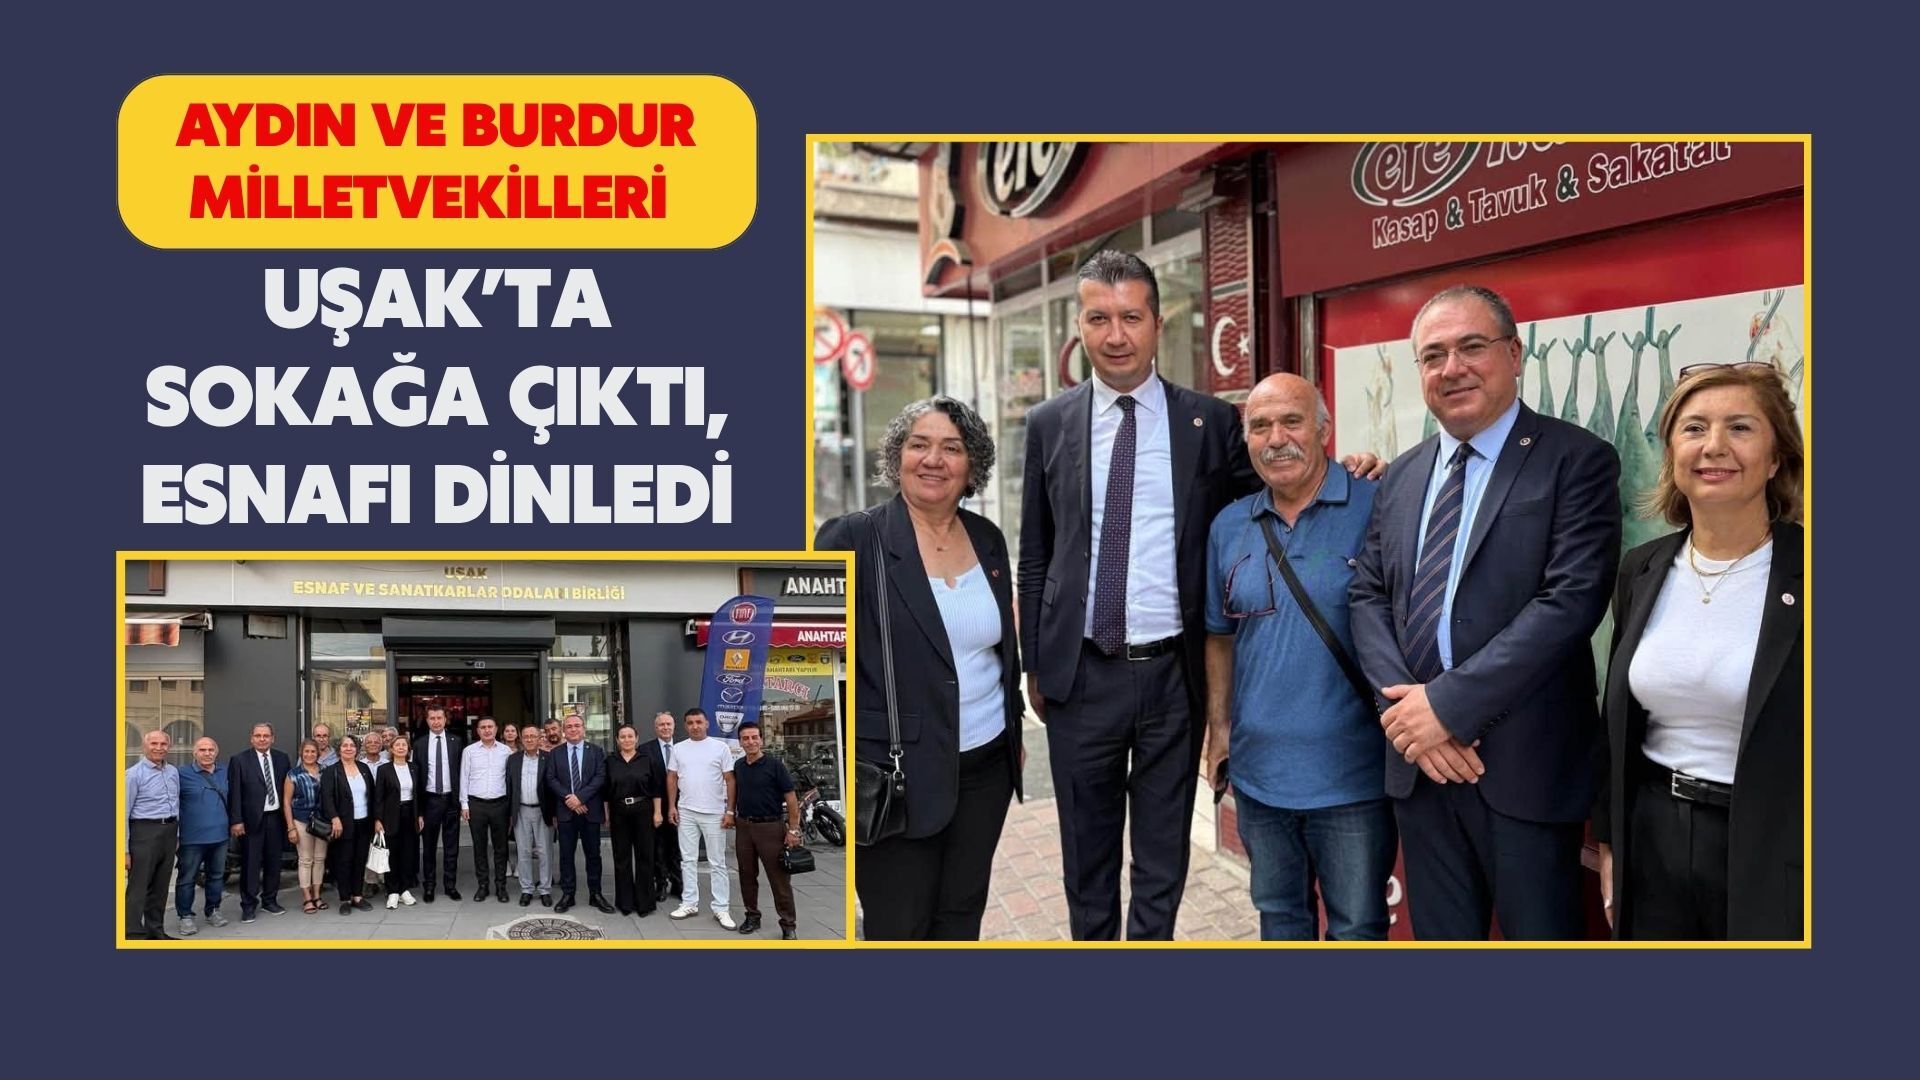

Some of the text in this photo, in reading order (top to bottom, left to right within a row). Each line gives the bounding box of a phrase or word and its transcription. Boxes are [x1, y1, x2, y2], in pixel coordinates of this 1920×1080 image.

[1371, 208, 1439, 249] Kasap
[1445, 196, 1465, 229] &
[1468, 173, 1548, 224] Tavuk
[1556, 164, 1580, 203] &
[1587, 142, 1732, 193] Sakatat
[443, 566, 489, 580] UŞAK
[292, 581, 351, 595] ESNAF
[353, 582, 375, 596] VE
[378, 583, 498, 599] SANATKARLAR
[572, 584, 626, 601] BİRLİĞİ
[722, 673, 746, 685] Ford
